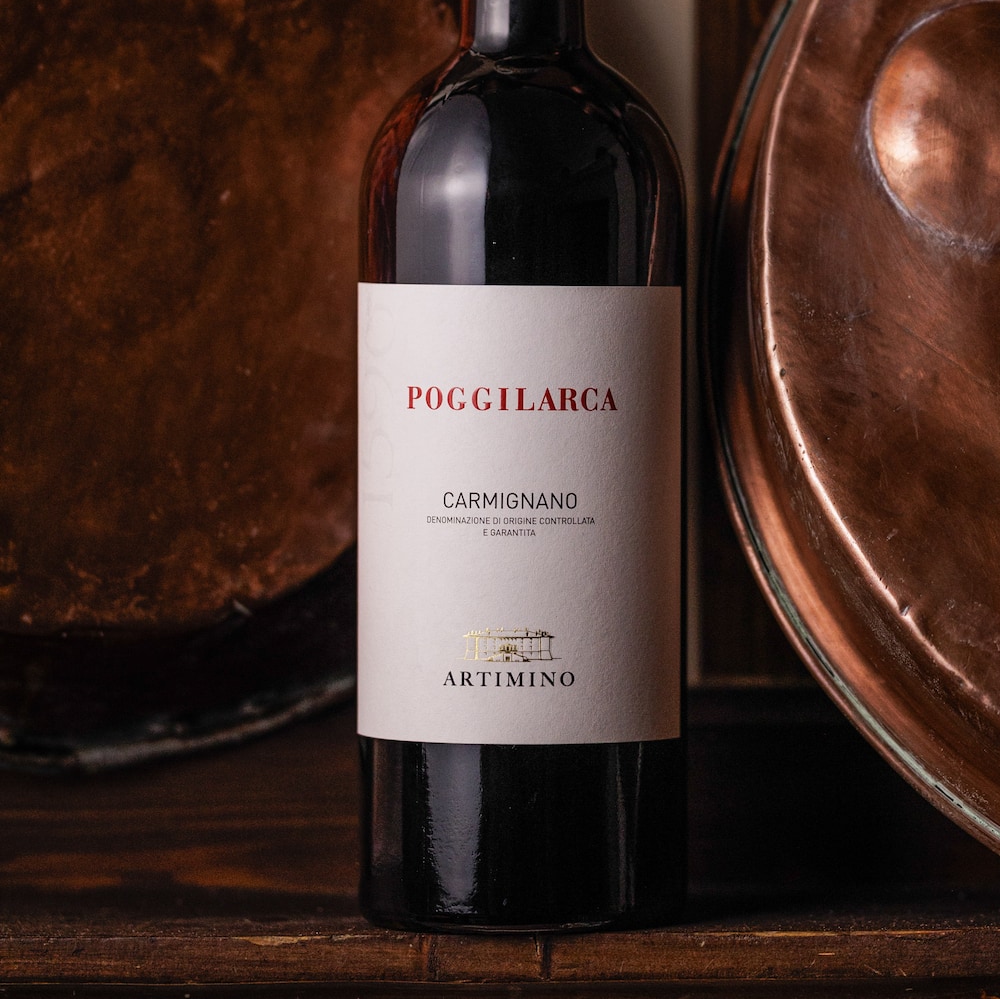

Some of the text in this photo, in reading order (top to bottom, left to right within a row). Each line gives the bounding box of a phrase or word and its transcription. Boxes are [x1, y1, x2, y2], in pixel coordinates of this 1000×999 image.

[407, 385, 618, 411] POGGILARCA
[443, 491, 577, 509] CARMIGNANO
[426, 515, 595, 525] DENOMINAZIONE DI ORIGINE CONTROLLATA
[483, 529, 536, 537] E GARANTITA
[443, 671, 575, 687] ARTIMINO
